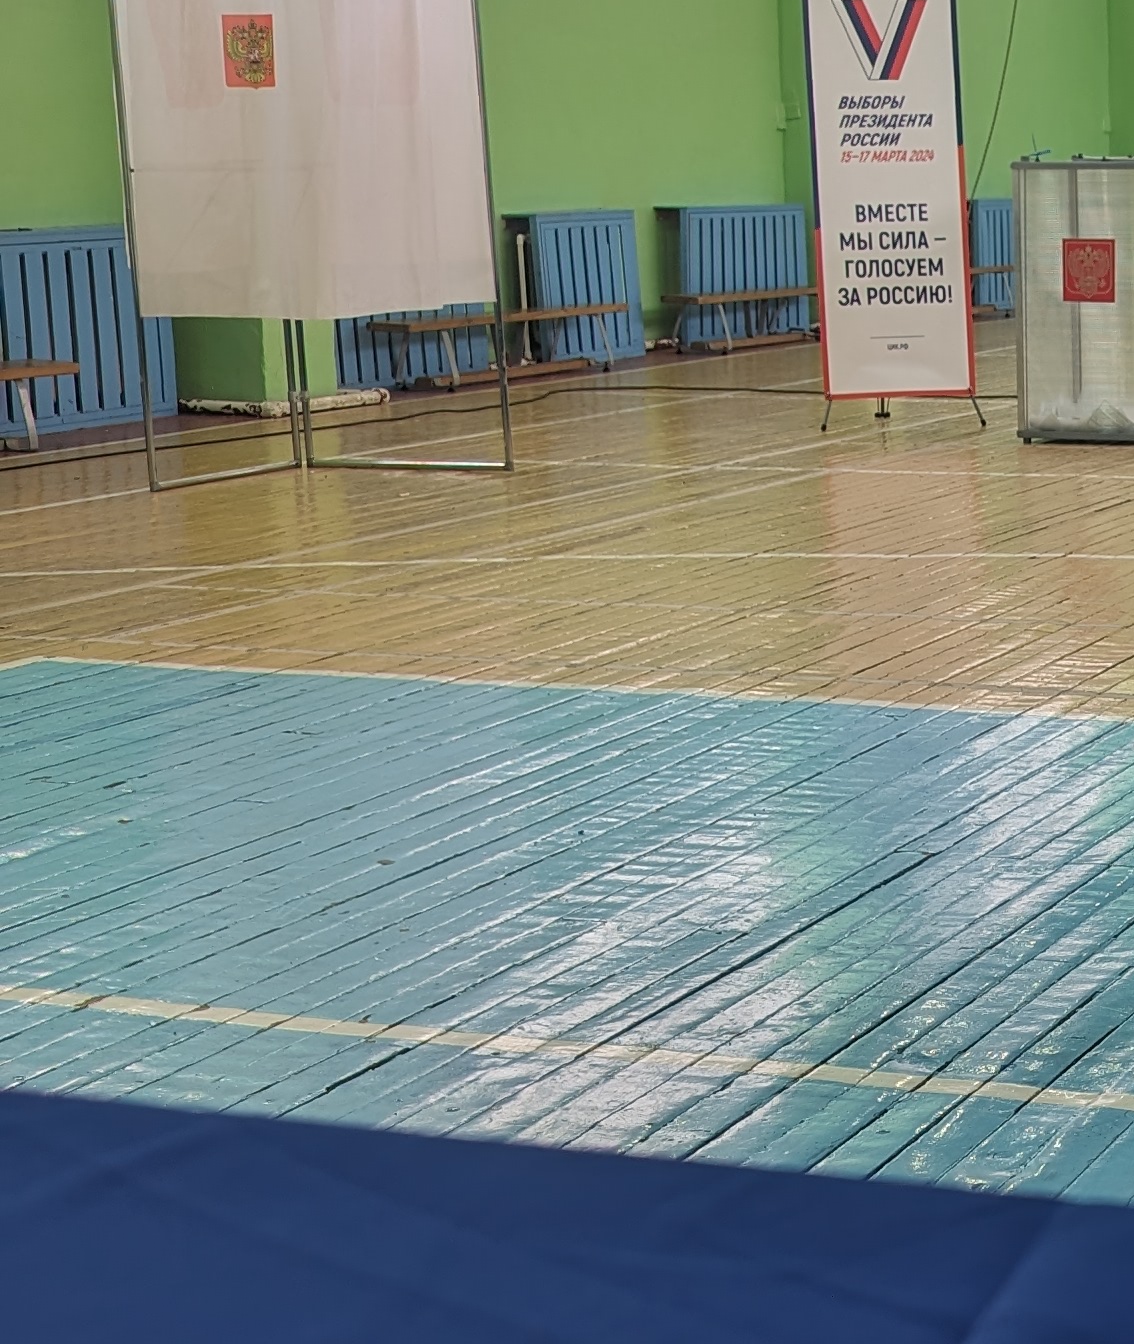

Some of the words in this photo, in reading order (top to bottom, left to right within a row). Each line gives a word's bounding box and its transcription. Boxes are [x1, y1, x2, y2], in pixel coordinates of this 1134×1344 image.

[838, 95, 905, 110] ВЫБОРЫ
[839, 113, 933, 129] ПРЕЗИДЕНТА
[840, 132, 902, 147] РОССИИ
[870, 150, 907, 162] МАРТА
[908, 149, 935, 162] 2024
[855, 203, 929, 223] ВМЕСТЕ
[839, 232, 873, 251] МЫ
[878, 231, 929, 250] СИЛА
[845, 258, 944, 279] ГОЛОСУЕМ
[838, 287, 862, 307] ЗА
[867, 285, 953, 305] РОССИЮ!
